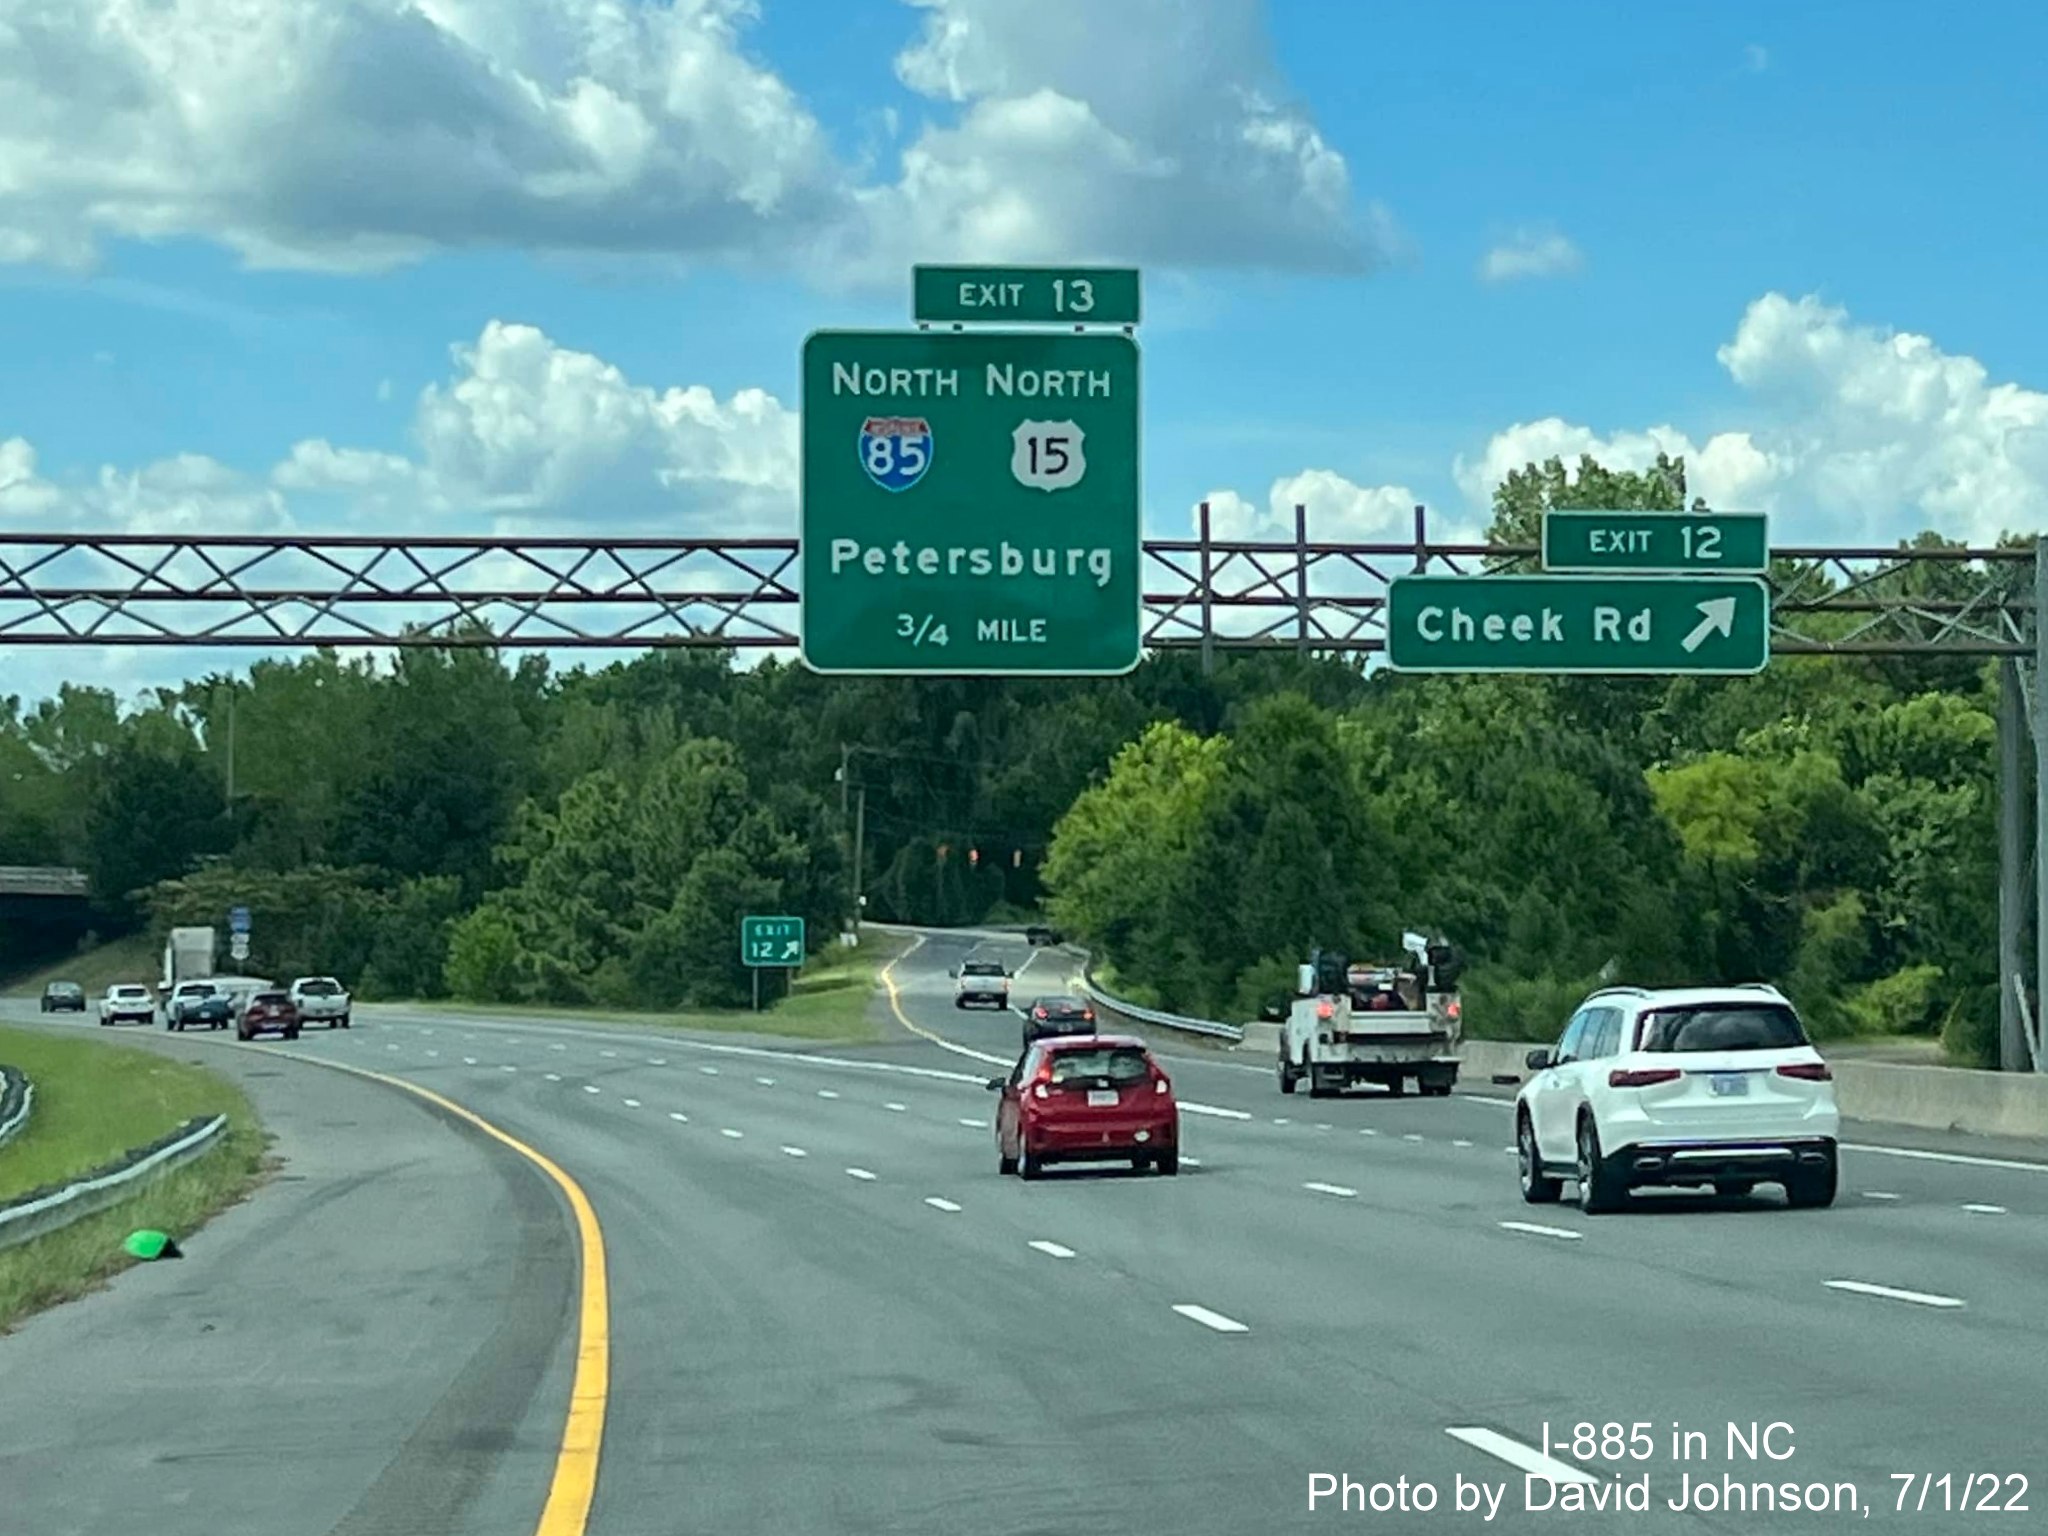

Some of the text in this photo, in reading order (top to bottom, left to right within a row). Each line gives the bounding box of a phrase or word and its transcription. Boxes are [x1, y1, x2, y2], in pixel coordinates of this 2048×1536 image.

[959, 279, 1095, 313] EXIT 13
[832, 362, 1110, 397] NORTH NORTH
[868, 435, 925, 475] 85
[1028, 436, 1069, 475] 15
[1589, 525, 1723, 559] EXIT 12
[831, 538, 1111, 587] Petersburg
[897, 613, 1047, 647] 3/4 MILE
[1417, 606, 1651, 642] Cheek Rd
[751, 941, 774, 958] 12
